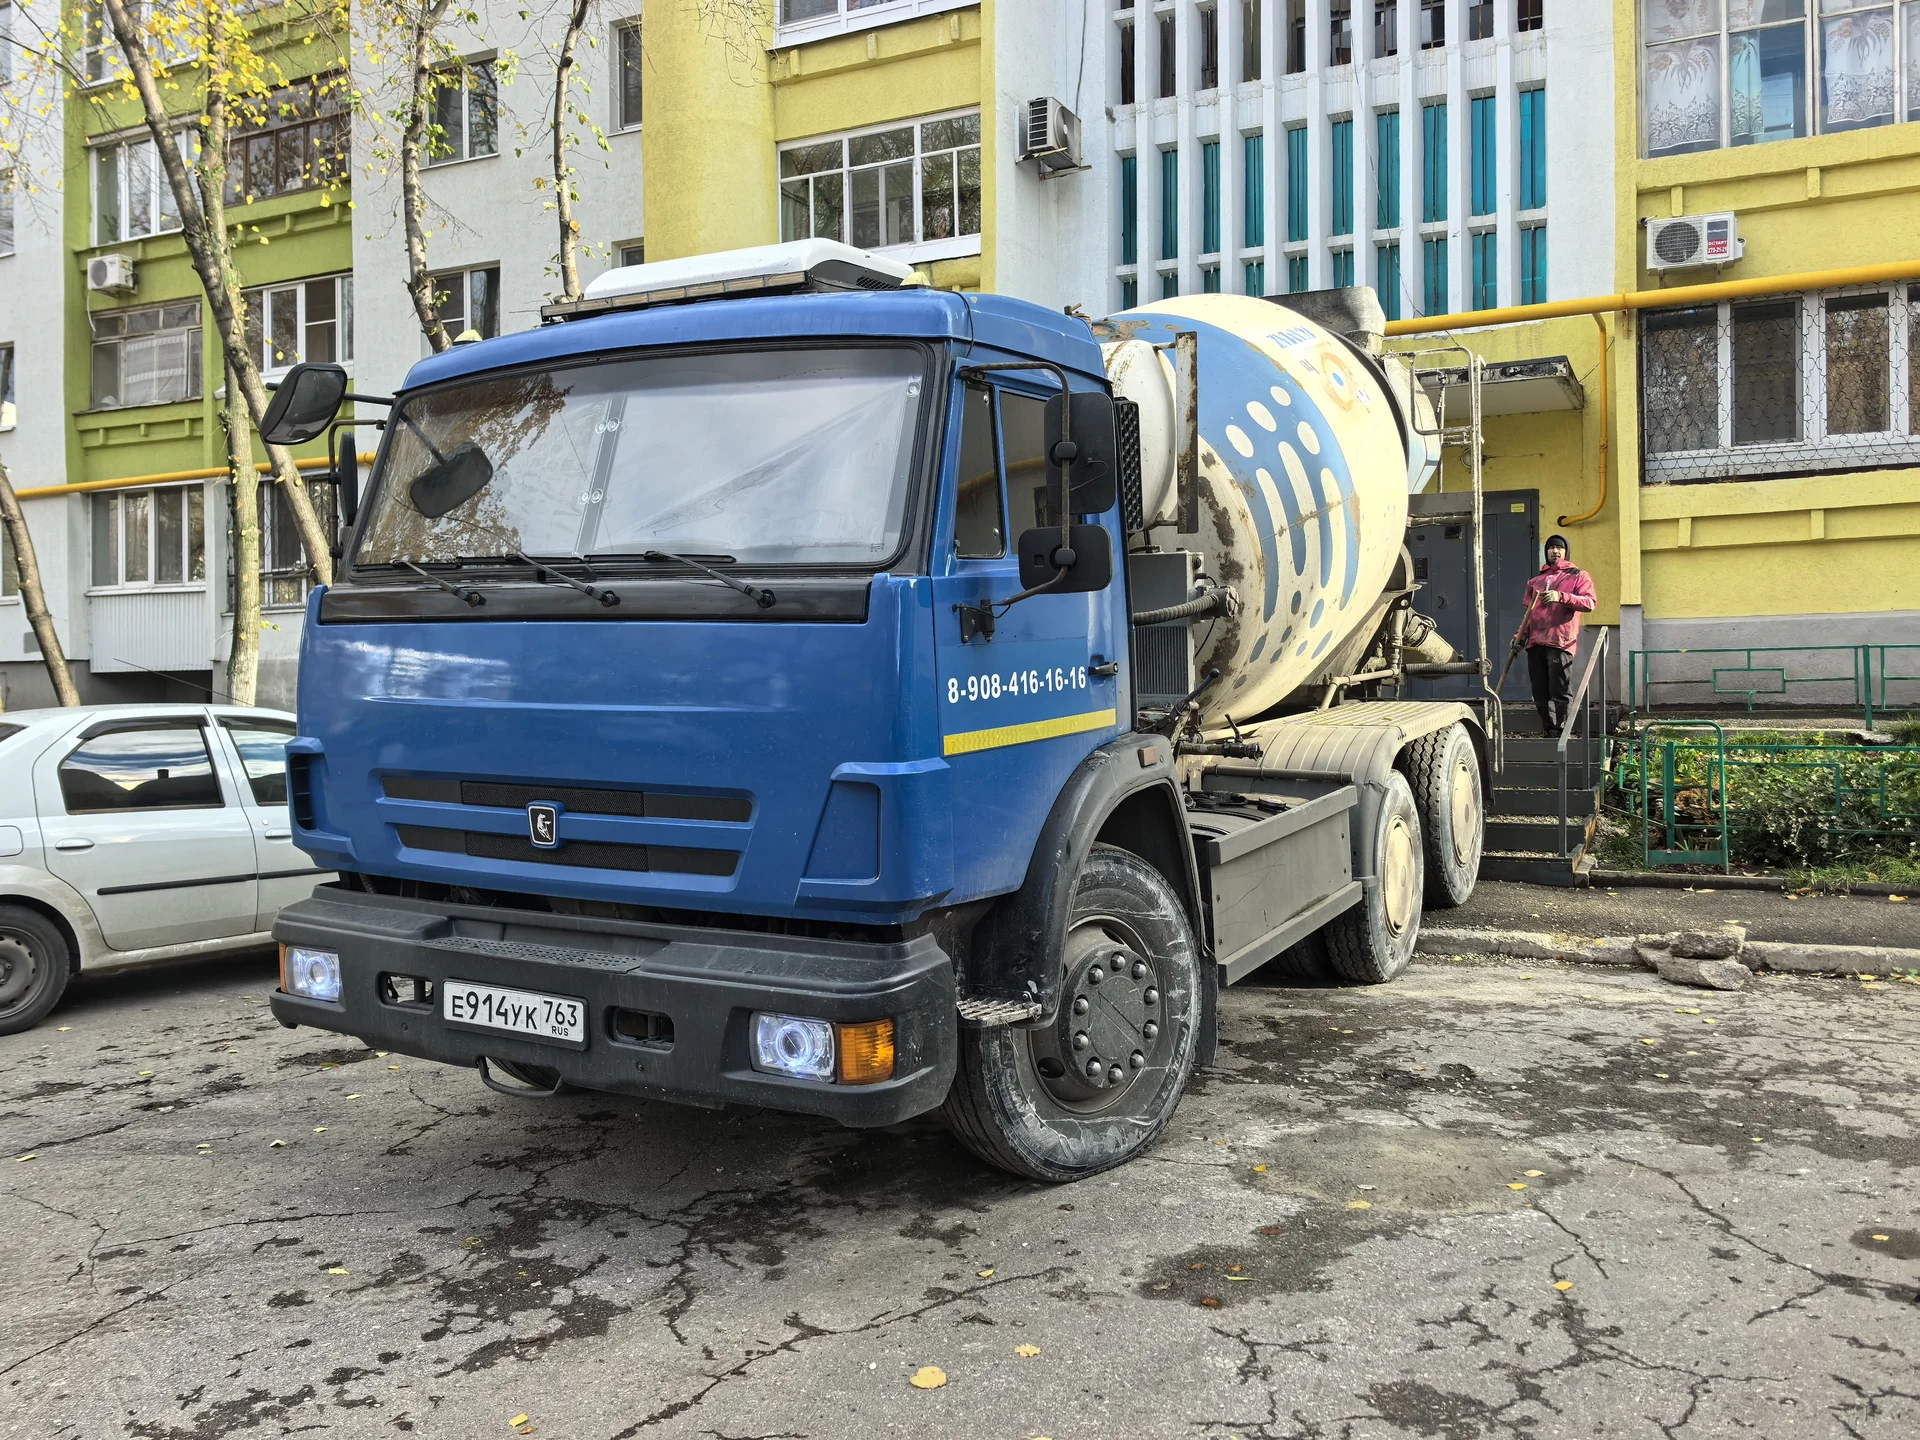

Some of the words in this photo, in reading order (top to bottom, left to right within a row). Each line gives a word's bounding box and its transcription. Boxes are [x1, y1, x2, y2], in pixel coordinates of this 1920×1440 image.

[947, 666, 1086, 704] 8-908-416-16-16
[452, 991, 538, 1030] Е914УК
[543, 1000, 577, 1027] 763
[551, 1026, 569, 1036] RUS
